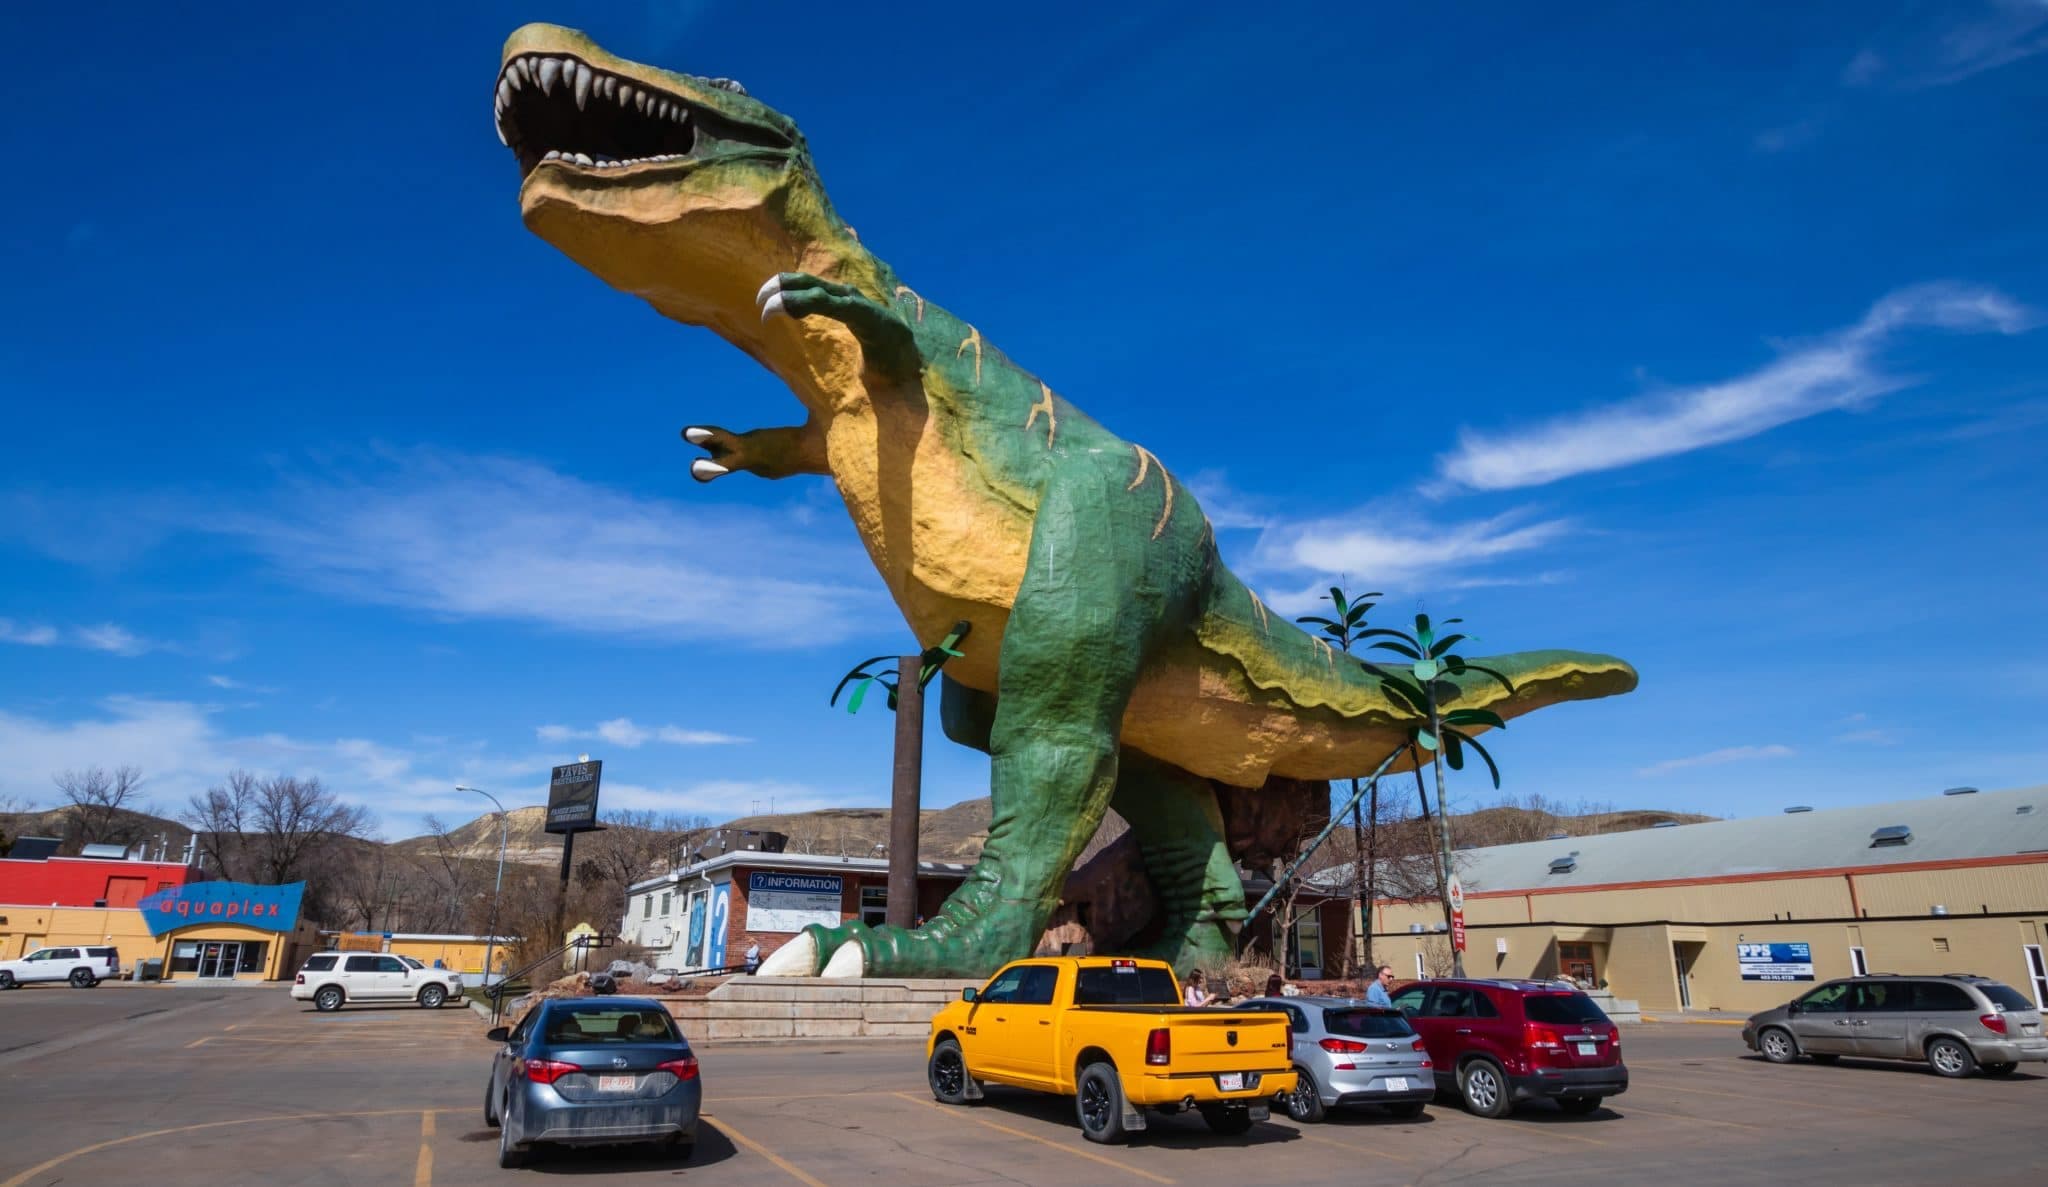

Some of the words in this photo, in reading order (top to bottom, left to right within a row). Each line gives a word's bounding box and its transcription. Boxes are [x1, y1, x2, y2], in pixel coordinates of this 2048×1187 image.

[767, 876, 839, 890] INFORMATION
[160, 898, 279, 918] aquaplex
[1738, 944, 1771, 957] PPS
